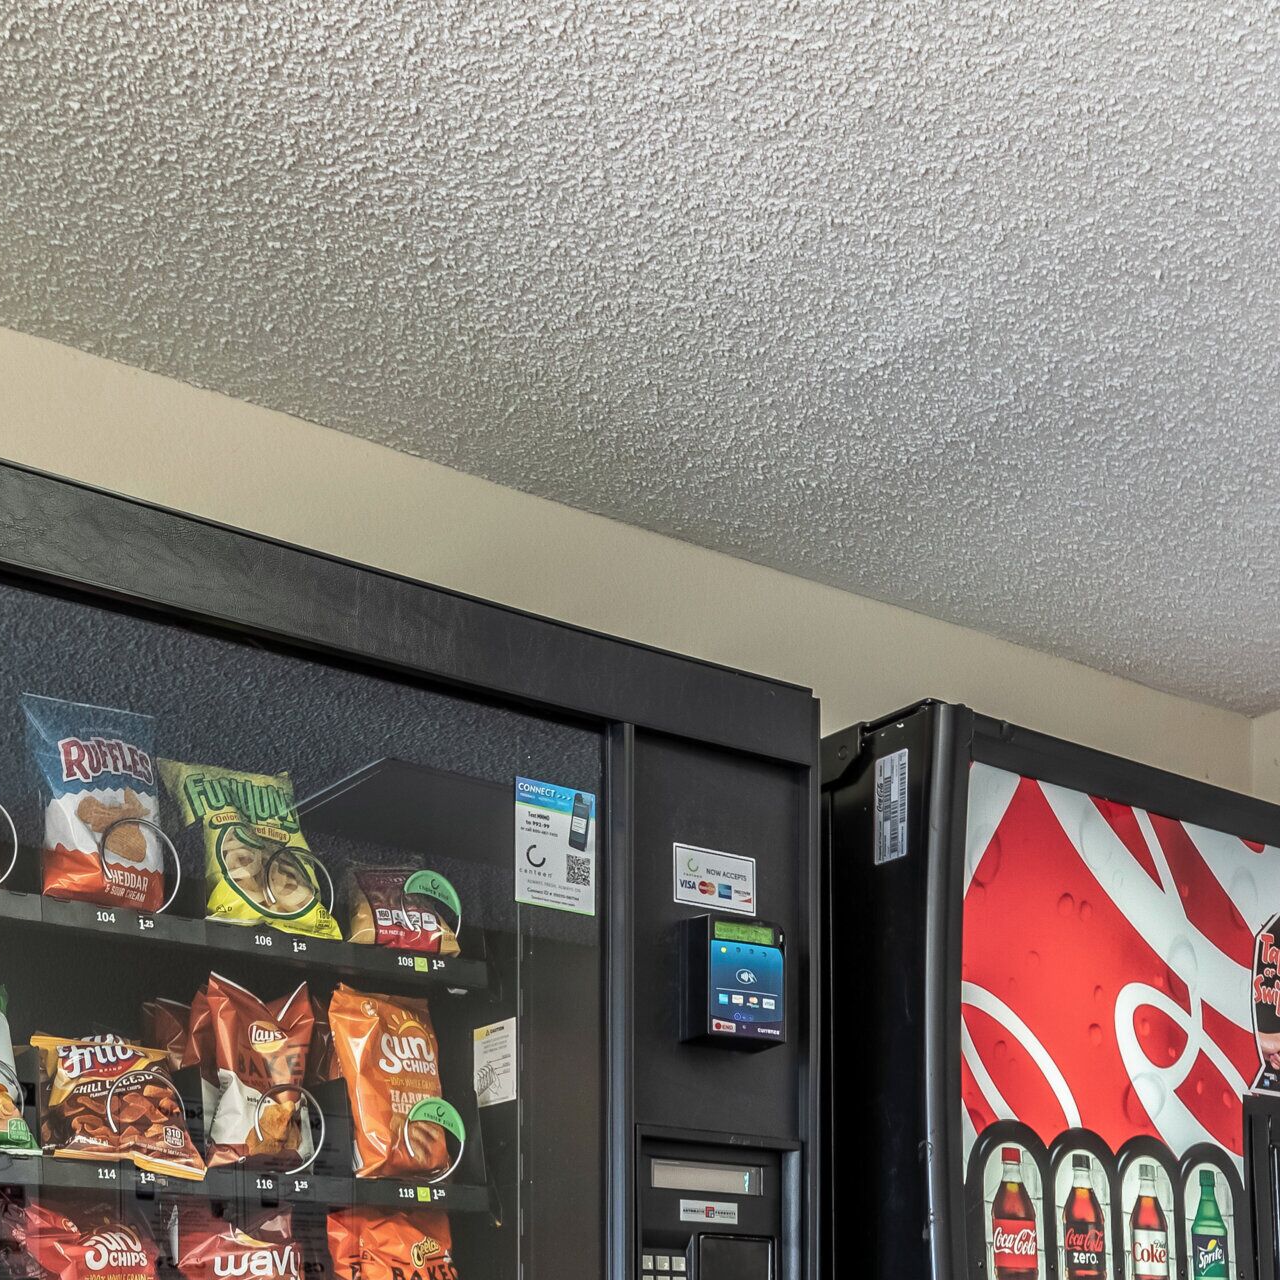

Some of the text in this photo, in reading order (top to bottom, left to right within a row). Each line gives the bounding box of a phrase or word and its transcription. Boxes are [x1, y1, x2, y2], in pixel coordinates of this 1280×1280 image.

[58, 737, 154, 787] RUFFLES
[518, 782, 556, 798] CONNECT
[706, 868, 747, 882] NOW ACCEPTS
[679, 879, 697, 891] VISA
[125, 890, 145, 903] CREAM
[97, 912, 115, 924] 104
[255, 936, 272, 946] 106
[398, 957, 413, 966] 108
[379, 1033, 434, 1074] Sun
[403, 1059, 436, 1076] CHIPS
[73, 1083, 102, 1094] CHILI
[166, 1128, 181, 1138] 310
[98, 1169, 116, 1179] 114
[256, 1179, 273, 1190] 116
[399, 1188, 414, 1198] 118
[993, 1227, 1036, 1255] Coca-Cola
[1065, 1228, 1104, 1252] Coca-Cola
[109, 1252, 147, 1267] CHIPS
[1133, 1243, 1167, 1264] Coke
[1199, 1247, 1224, 1268] Sprite
